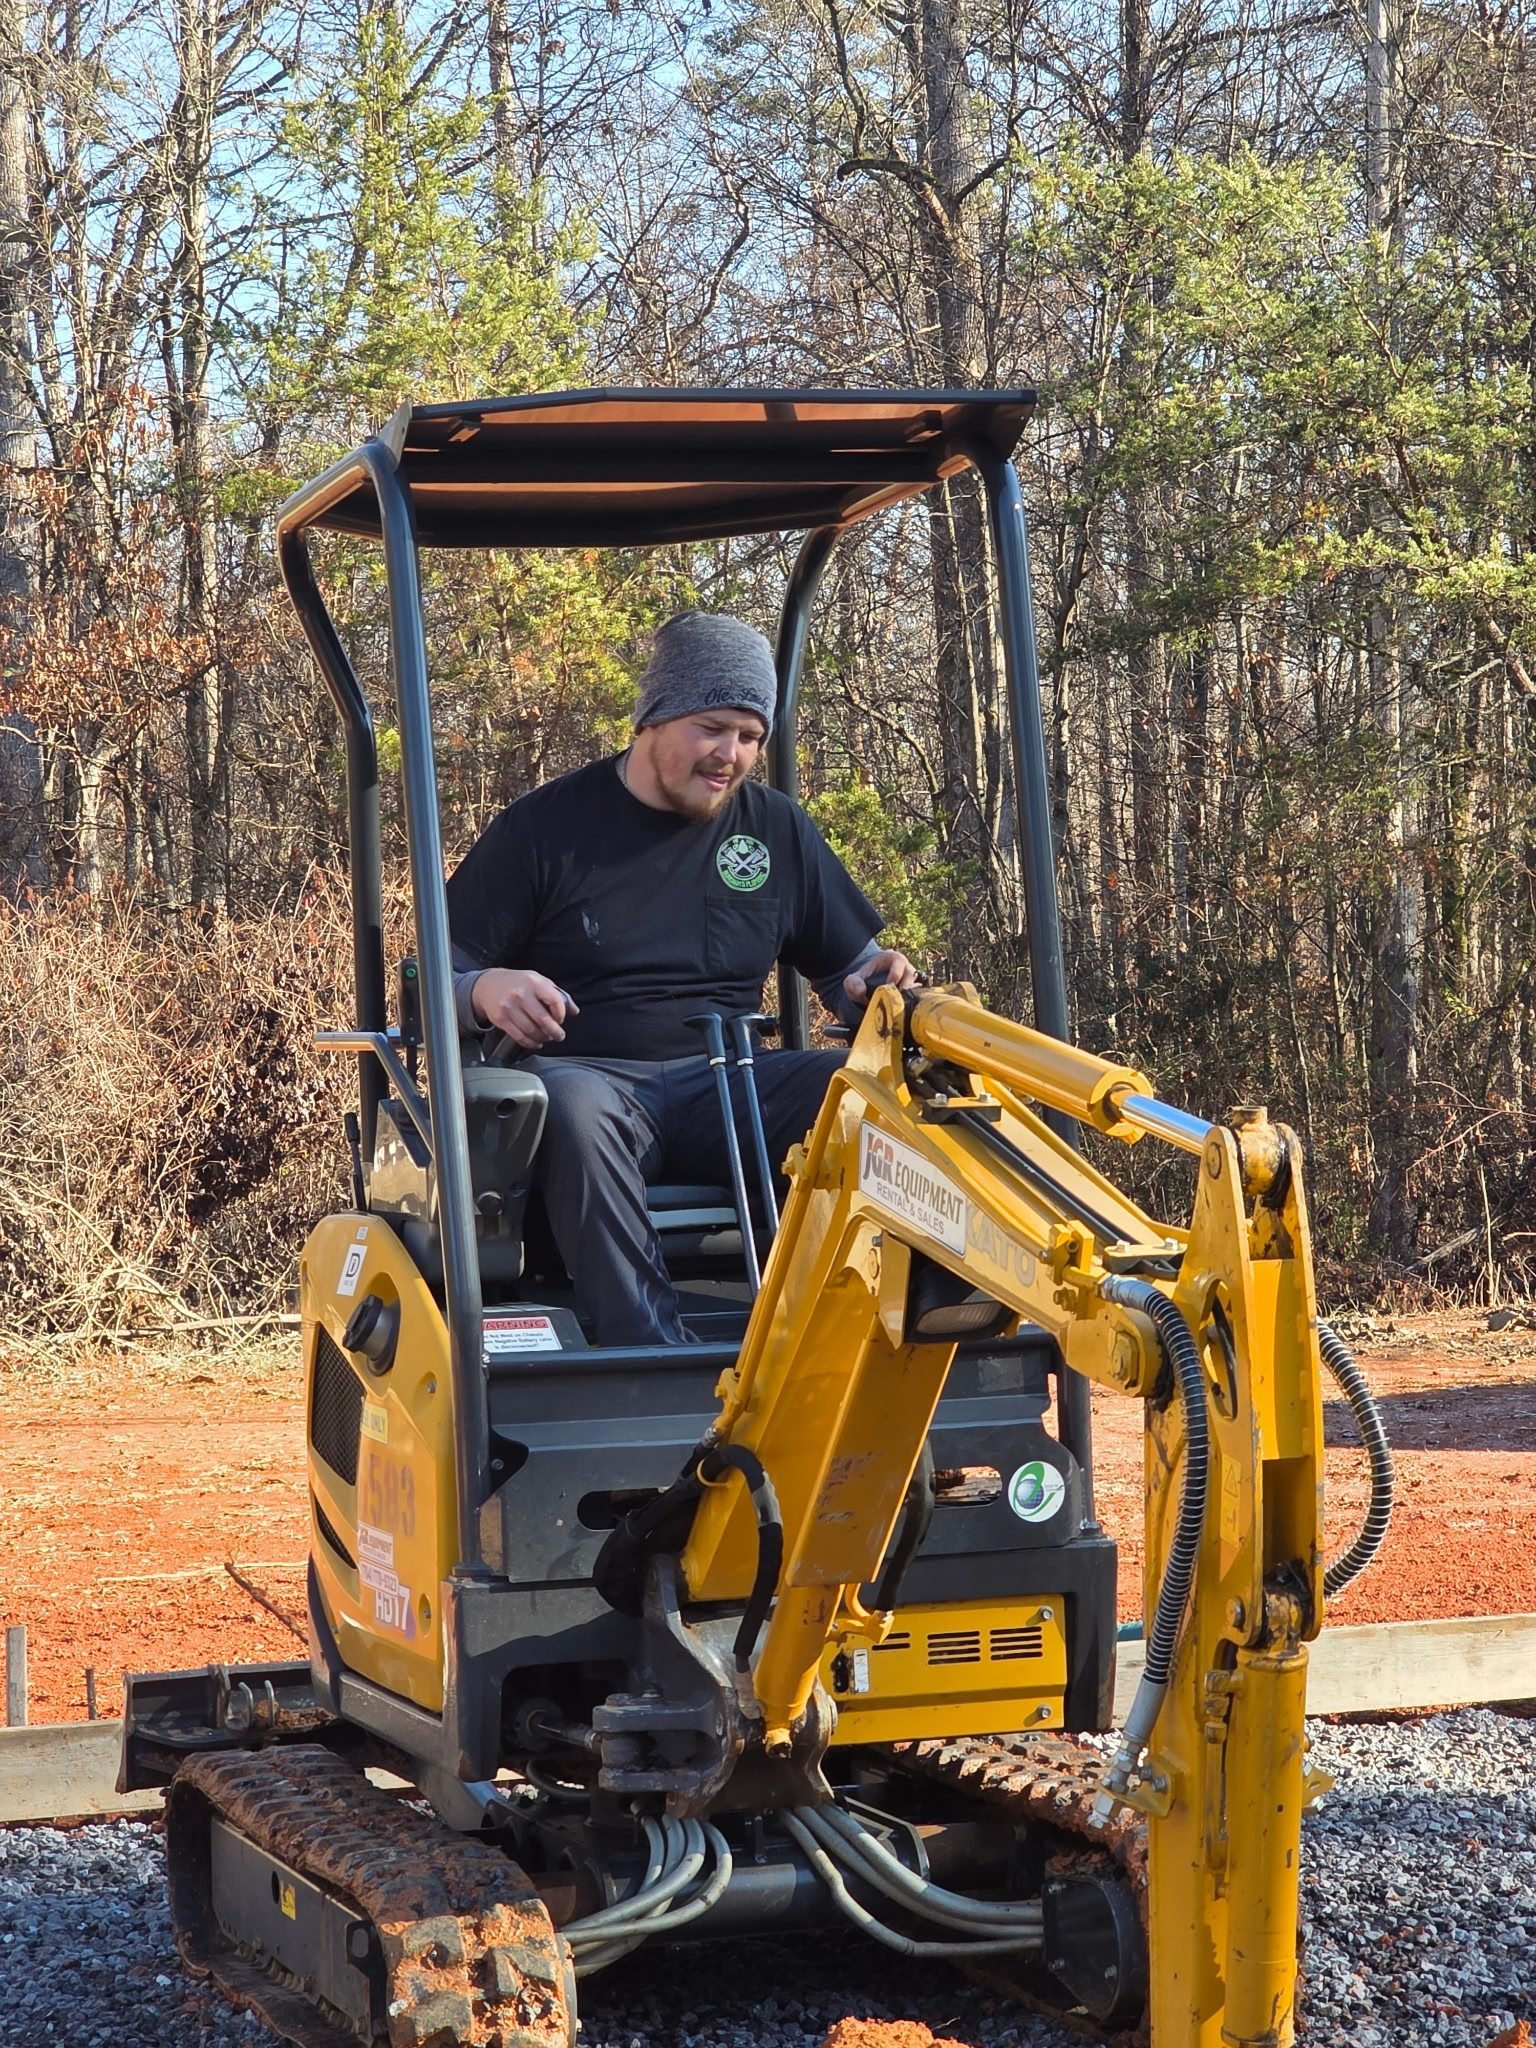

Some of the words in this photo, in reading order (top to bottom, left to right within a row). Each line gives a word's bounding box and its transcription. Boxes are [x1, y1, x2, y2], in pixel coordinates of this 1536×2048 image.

[863, 1132, 893, 1185] JGR
[894, 1160, 964, 1225] EQUIPMENT
[877, 1182, 908, 1213] RENTAL
[909, 1204, 916, 1217] &
[917, 1207, 945, 1236] SALES
[966, 1203, 1036, 1288] KATO
[484, 1319, 546, 1330] ARNING
